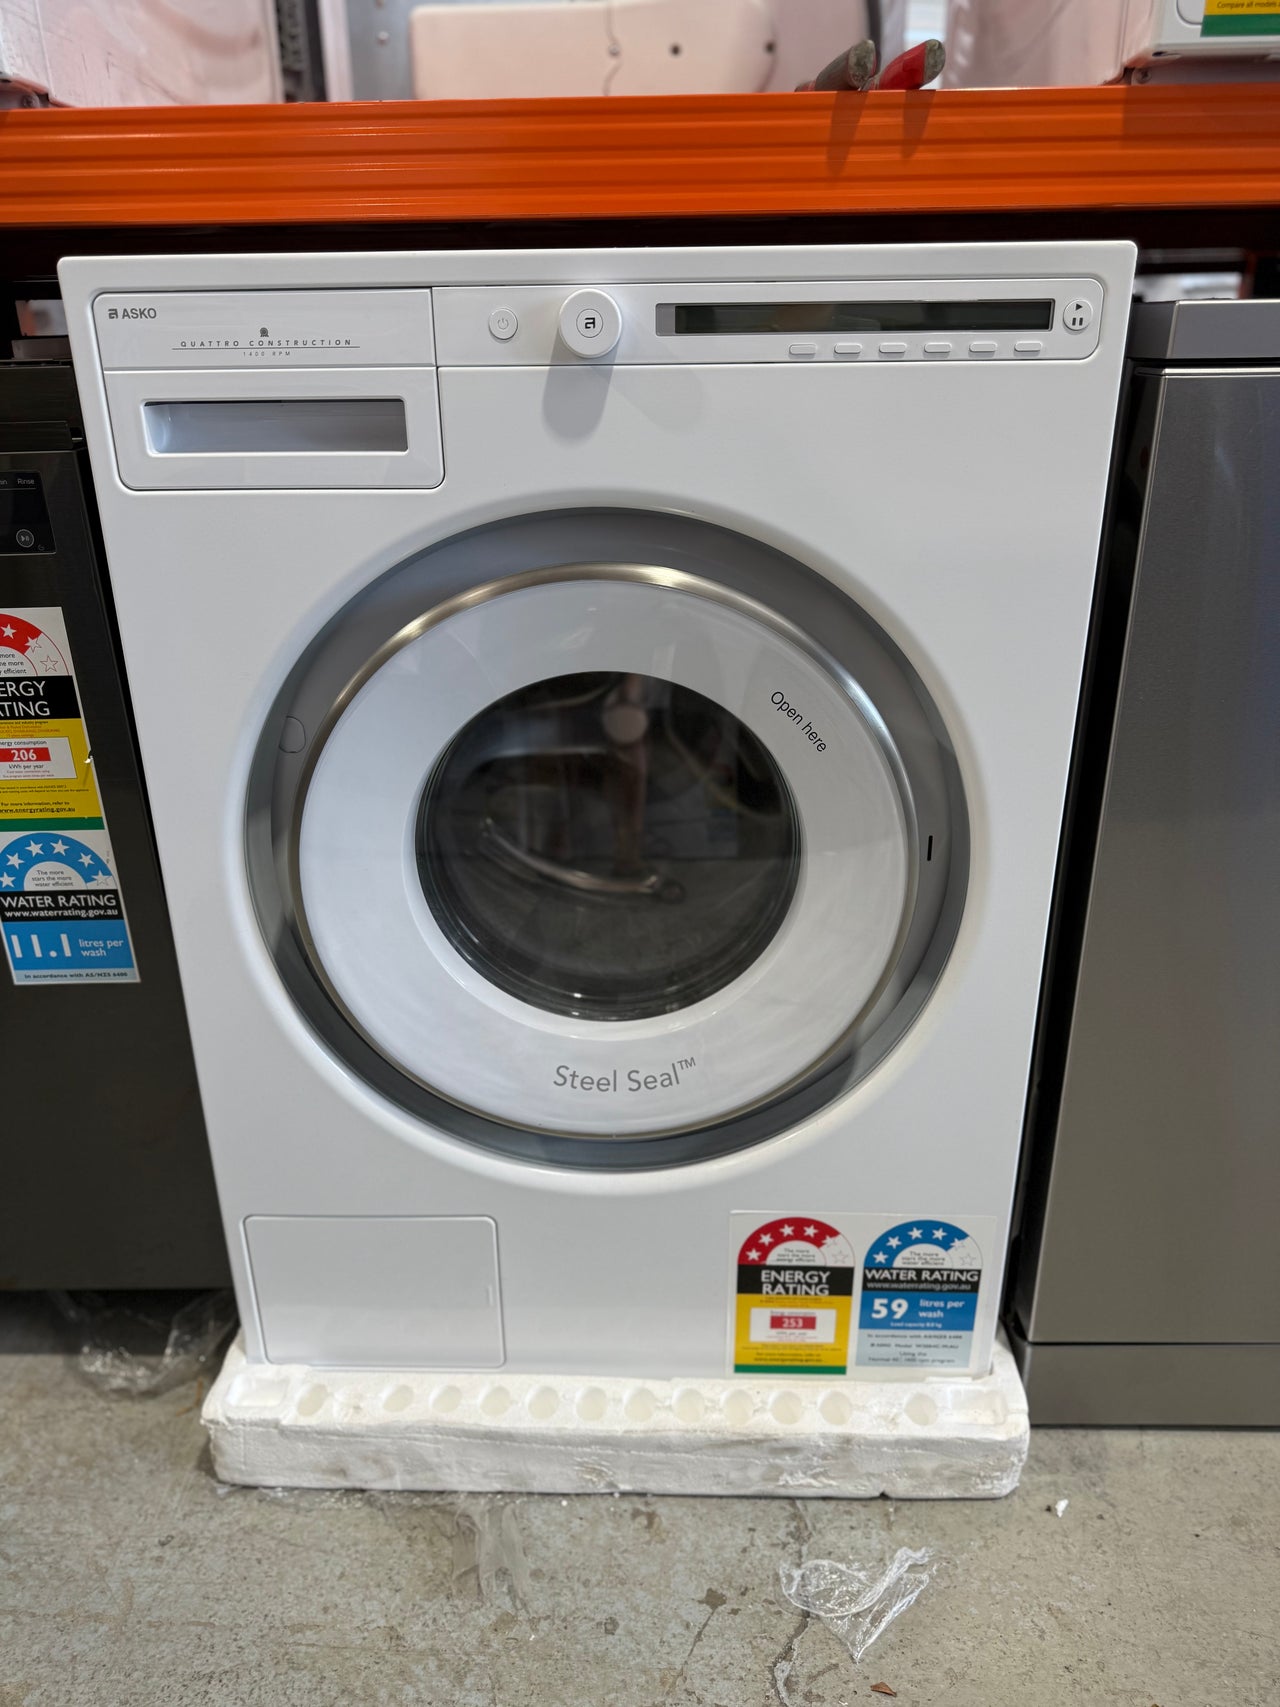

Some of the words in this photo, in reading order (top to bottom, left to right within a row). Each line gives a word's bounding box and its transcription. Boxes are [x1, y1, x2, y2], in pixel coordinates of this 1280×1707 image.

[121, 308, 157, 320] ASKO
[180, 340, 240, 348] QUATTRO
[249, 338, 351, 347] CONSTRUCTION
[770, 691, 804, 725] Open
[801, 721, 827, 752] here
[11, 749, 37, 761] 206
[1, 895, 55, 908] WATER
[57, 894, 117, 907] RATING
[4, 907, 119, 918] www.waterrating.gov.au
[10, 933, 72, 959] 11.1
[78, 939, 105, 948] litres
[106, 940, 124, 949] per
[80, 947, 107, 957] wash
[553, 1065, 617, 1092] Steel
[761, 1269, 831, 1284] ENERGY
[865, 1269, 917, 1281] WATER
[921, 1270, 979, 1282] RATING
[762, 1283, 830, 1296] RATING
[867, 1281, 972, 1292] www.waterrating.gov.au
[871, 1298, 908, 1319] 59
[919, 1299, 945, 1308] litres
[947, 1301, 965, 1309] per
[919, 1310, 944, 1318] wash
[782, 1318, 803, 1328] 253
